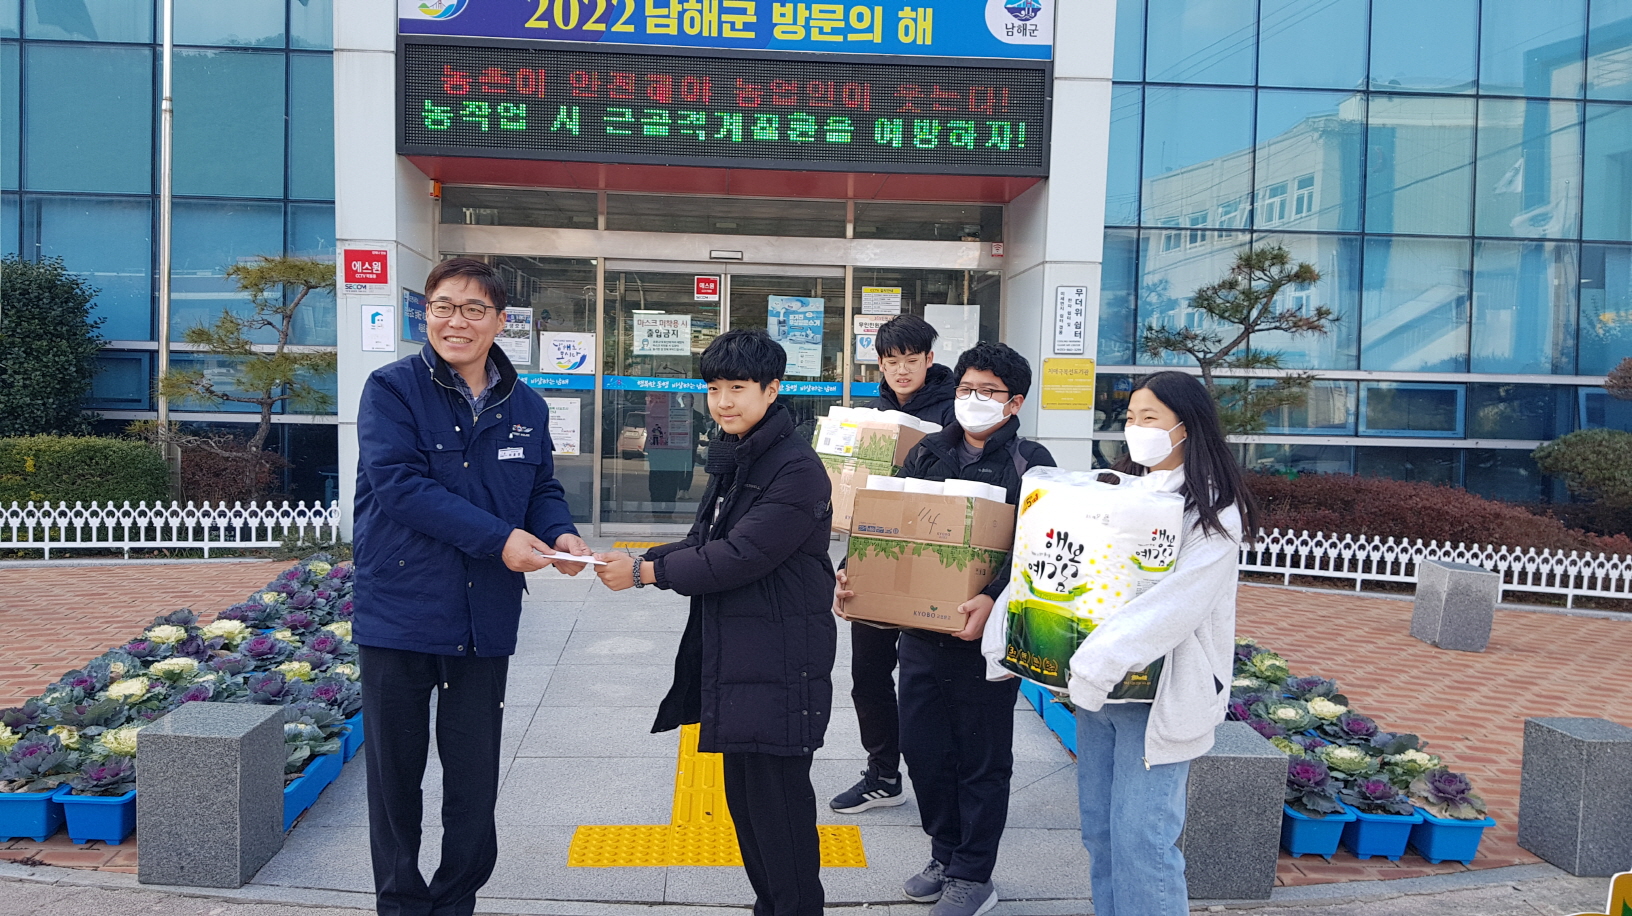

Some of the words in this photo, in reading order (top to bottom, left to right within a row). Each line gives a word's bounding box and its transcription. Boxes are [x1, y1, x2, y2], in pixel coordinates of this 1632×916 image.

[524, 0, 635, 33] 2022
[645, 0, 757, 38] 남해군
[772, 2, 882, 43] 방문의
[898, 7, 933, 45] 해
[1005, 22, 1039, 38] 남해군
[441, 65, 546, 98] 농촌이
[569, 71, 713, 105] 안전해야
[733, 77, 871, 112] 농업인이
[893, 83, 1009, 115] 웃는다!
[421, 100, 527, 132] 농작업
[550, 105, 580, 136] 시
[603, 107, 855, 143] 근골격계질환을
[873, 117, 1026, 151] 예방하자!
[351, 260, 382, 274] 에스원
[699, 282, 715, 290] 에스원
[1074, 288, 1084, 317] 무더위
[637, 319, 658, 327] 마스크
[659, 319, 679, 329] 미착용
[681, 320, 688, 328] 시
[1073, 320, 1082, 339] 쉼터
[646, 328, 679, 338] 출입금지
[913, 610, 936, 619] KYOBO
